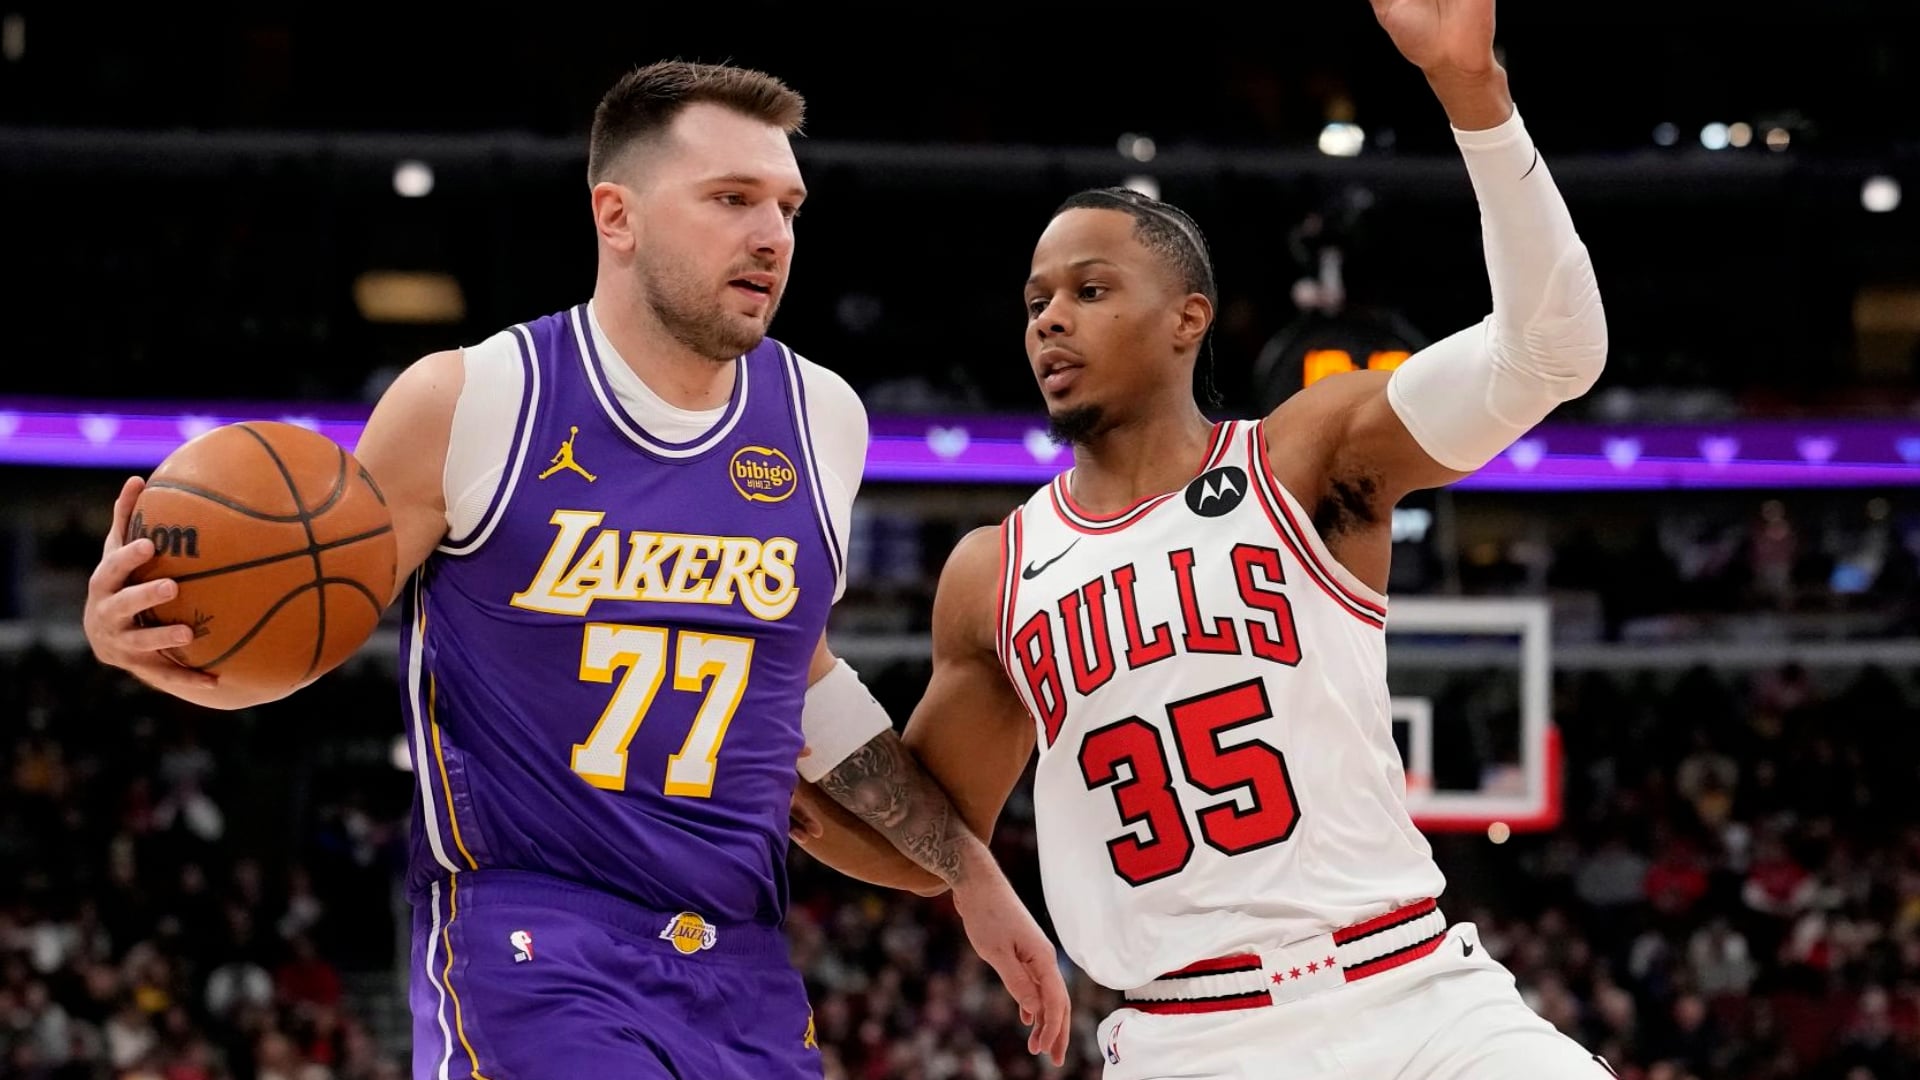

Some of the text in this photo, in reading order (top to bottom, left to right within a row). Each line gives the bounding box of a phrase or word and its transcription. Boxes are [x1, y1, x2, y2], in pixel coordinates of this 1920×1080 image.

[735, 460, 793, 486] bibigo
[509, 509, 800, 621] LAKERS
[570, 622, 756, 798] 77
[1012, 542, 1303, 749] BULLS
[1077, 676, 1302, 888] 35
[659, 917, 717, 950] LAKERS
